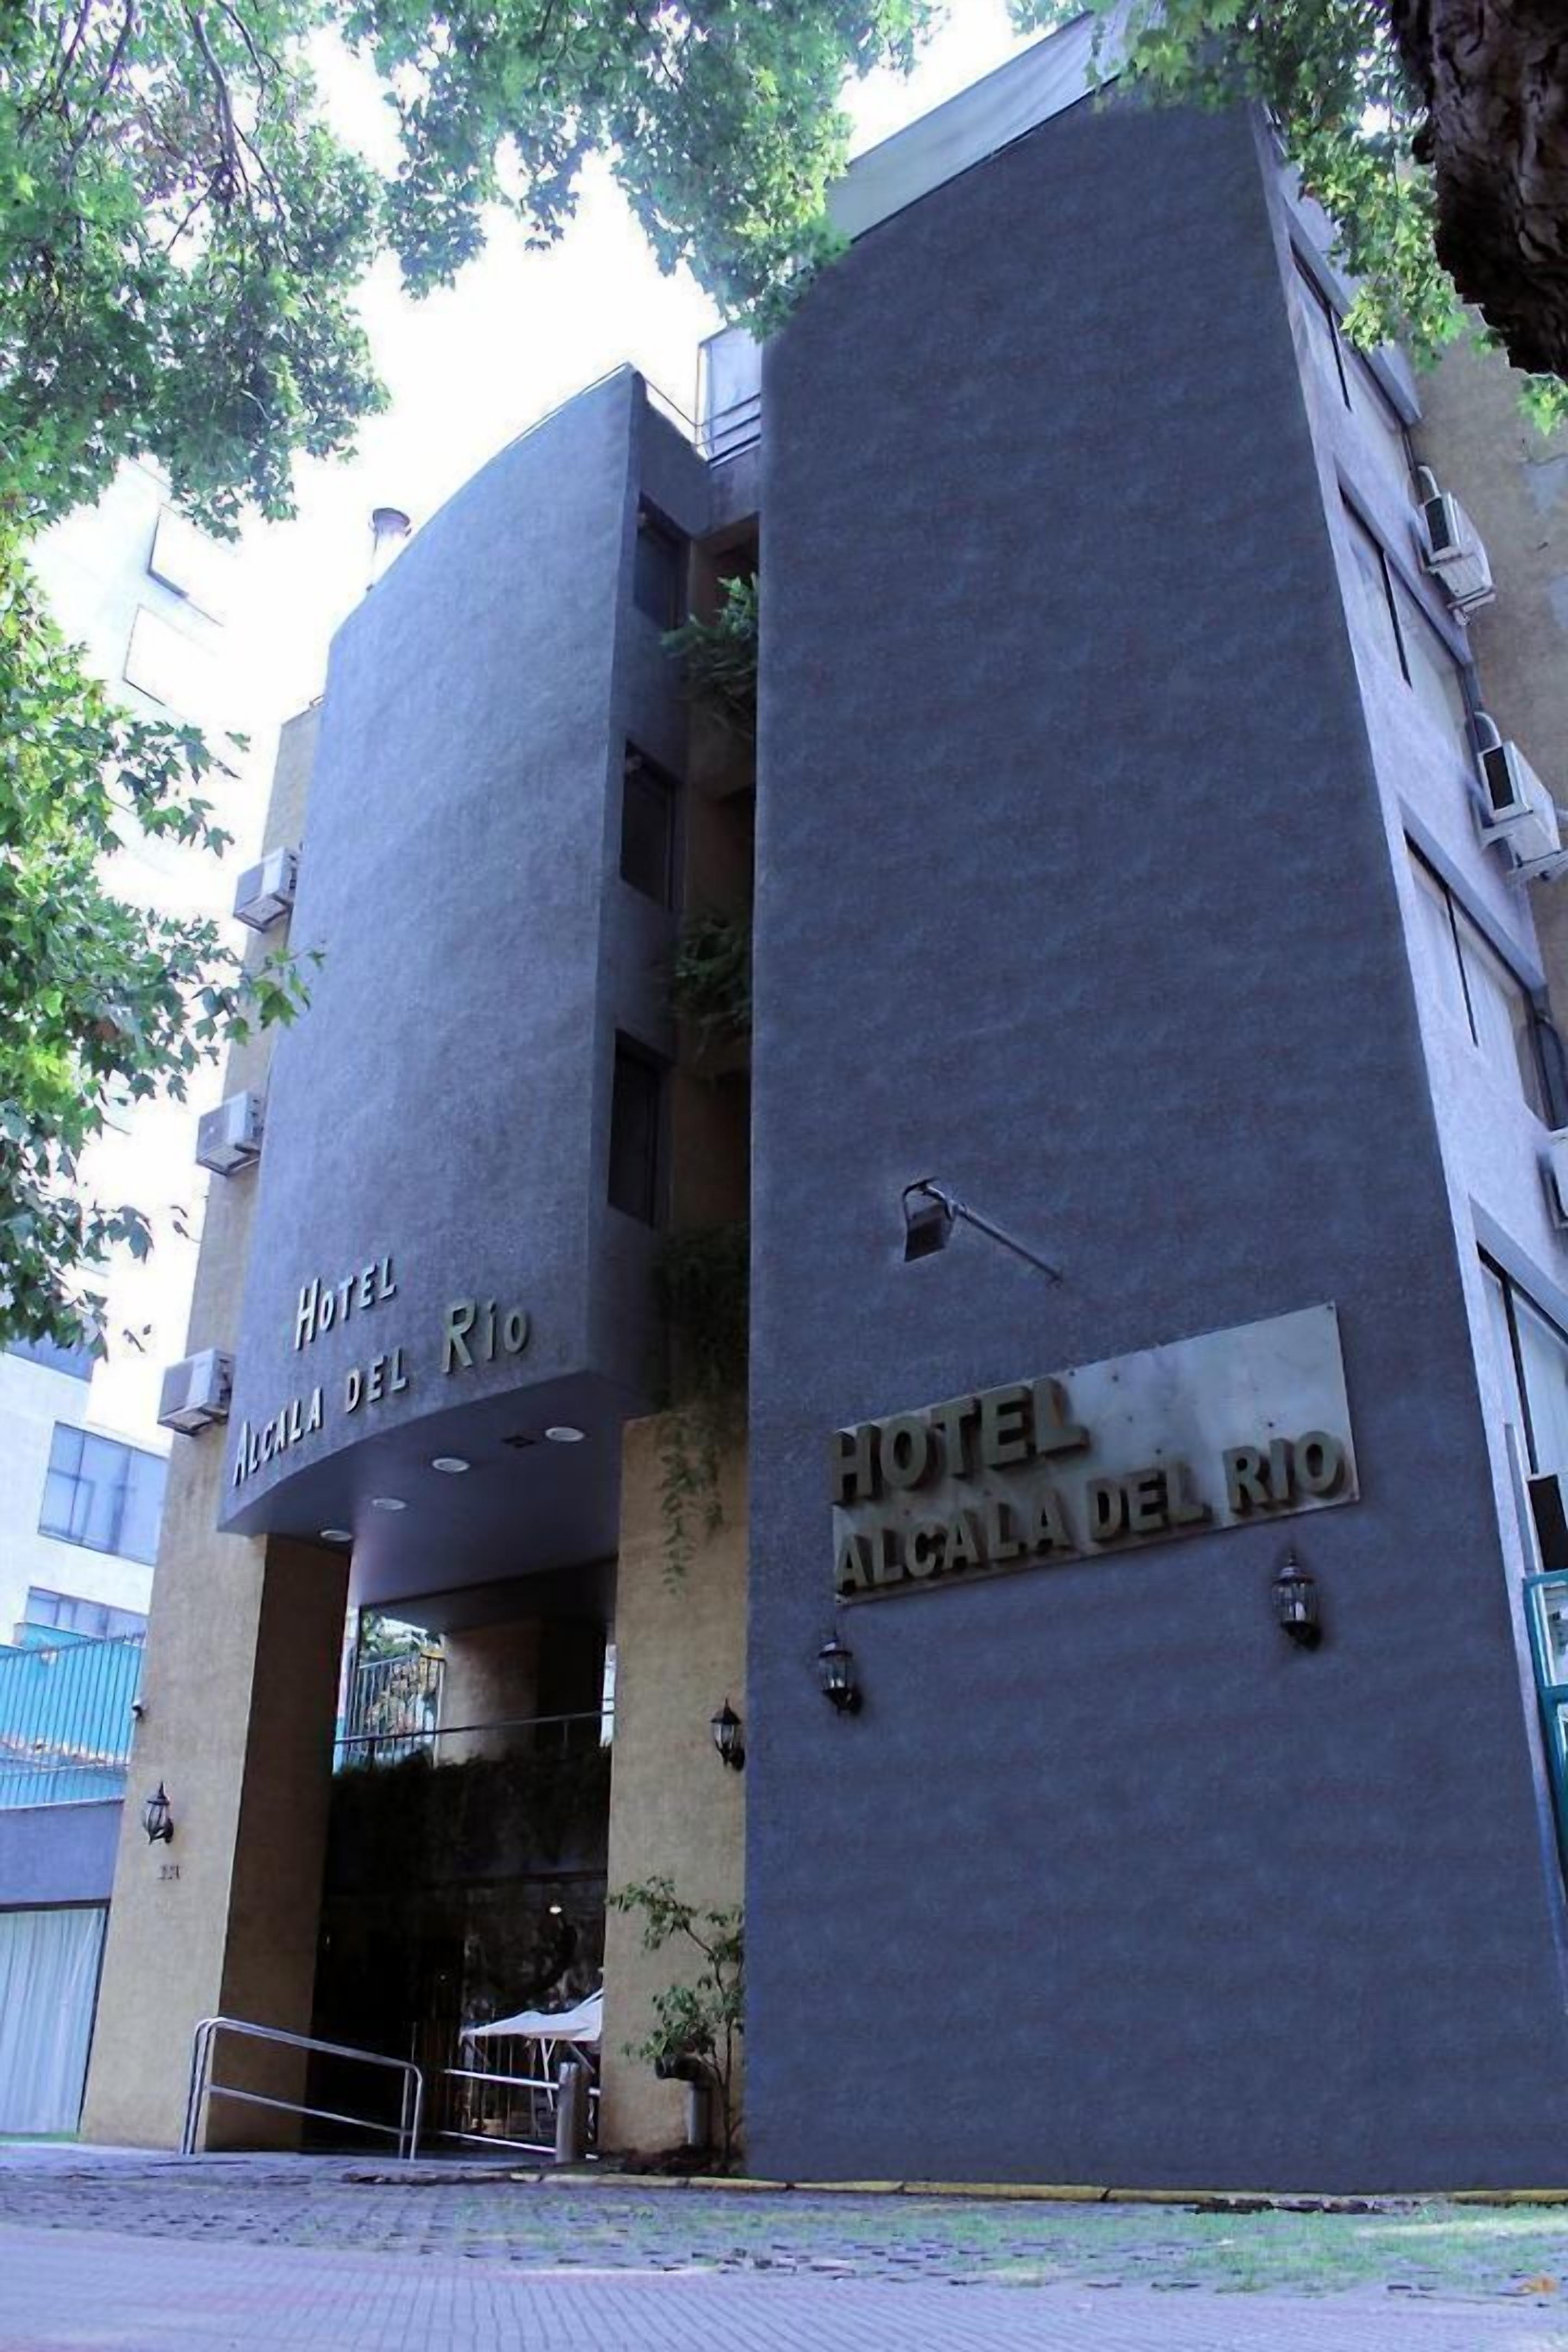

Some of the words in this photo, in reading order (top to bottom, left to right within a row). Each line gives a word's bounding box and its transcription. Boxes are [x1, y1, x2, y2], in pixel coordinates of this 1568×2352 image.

[831, 1376, 1091, 1506] HOTEL
[834, 1488, 1074, 1595] ALCALA
[1087, 1456, 1211, 1542] DEL
[1222, 1430, 1346, 1516] RIO
